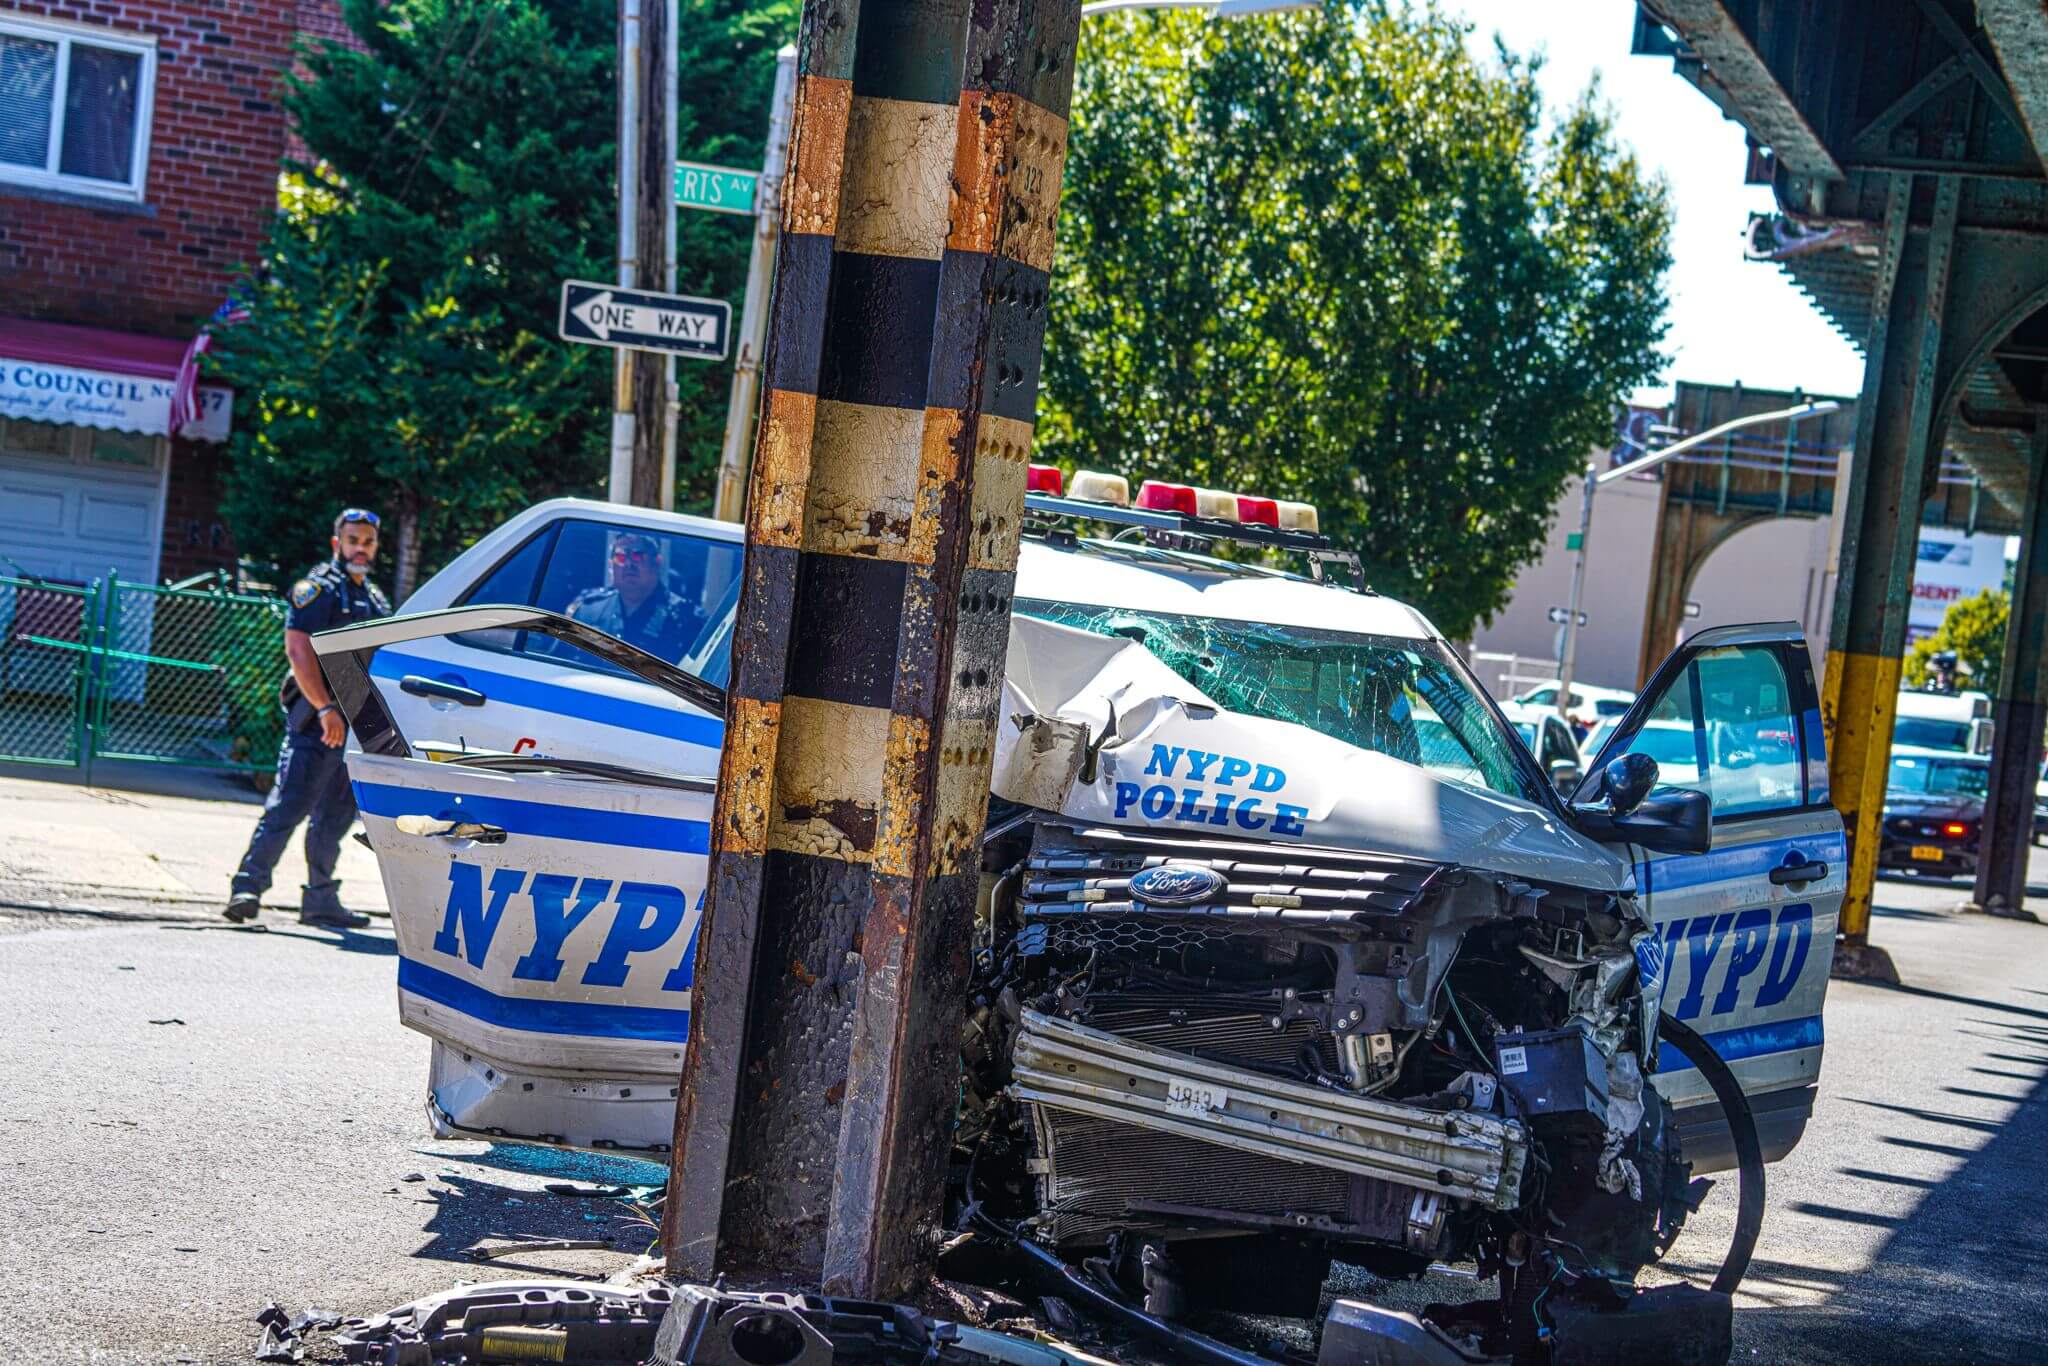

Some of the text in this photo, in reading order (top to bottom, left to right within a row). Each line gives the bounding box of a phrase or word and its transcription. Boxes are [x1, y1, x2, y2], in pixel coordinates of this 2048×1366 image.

[730, 177, 750, 193] AV
[589, 303, 707, 338] ONE WAY
[14, 366, 143, 401] COUNCIL
[1144, 743, 1287, 793] NYPD
[1114, 782, 1309, 837] POLICE
[1144, 869, 1197, 891] Ford
